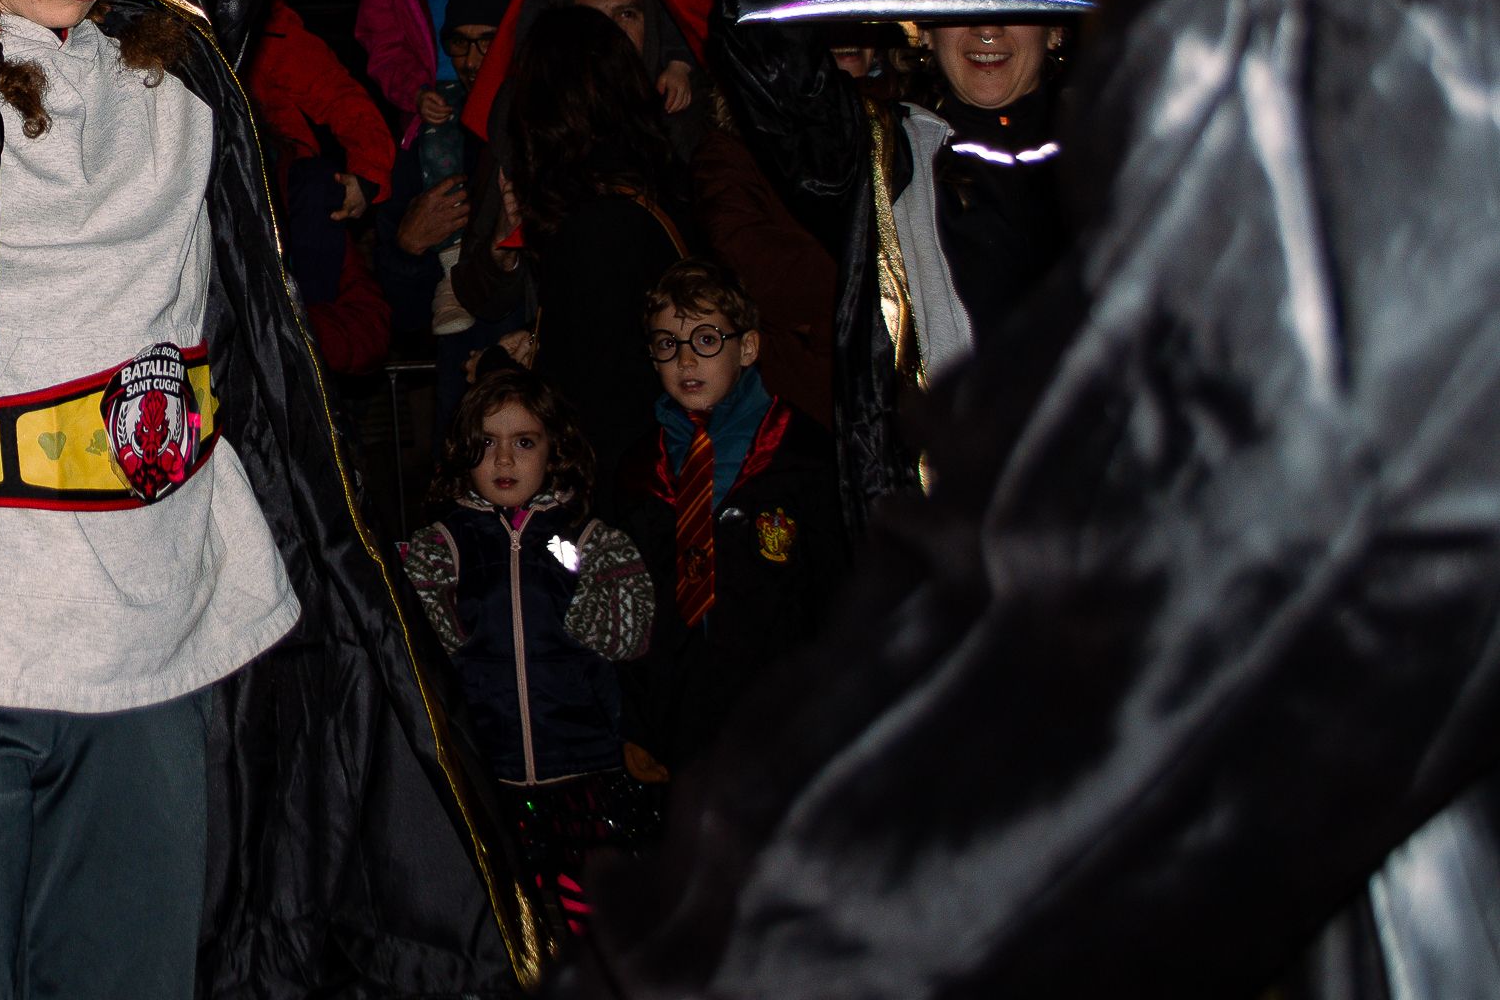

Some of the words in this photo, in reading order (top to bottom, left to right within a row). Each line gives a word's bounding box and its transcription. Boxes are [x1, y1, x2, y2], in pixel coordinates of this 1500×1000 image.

[161, 346, 180, 361] BOXA
[121, 360, 184, 385] BATALLEM
[126, 379, 151, 398] SANT
[153, 379, 180, 394] CUGAT
